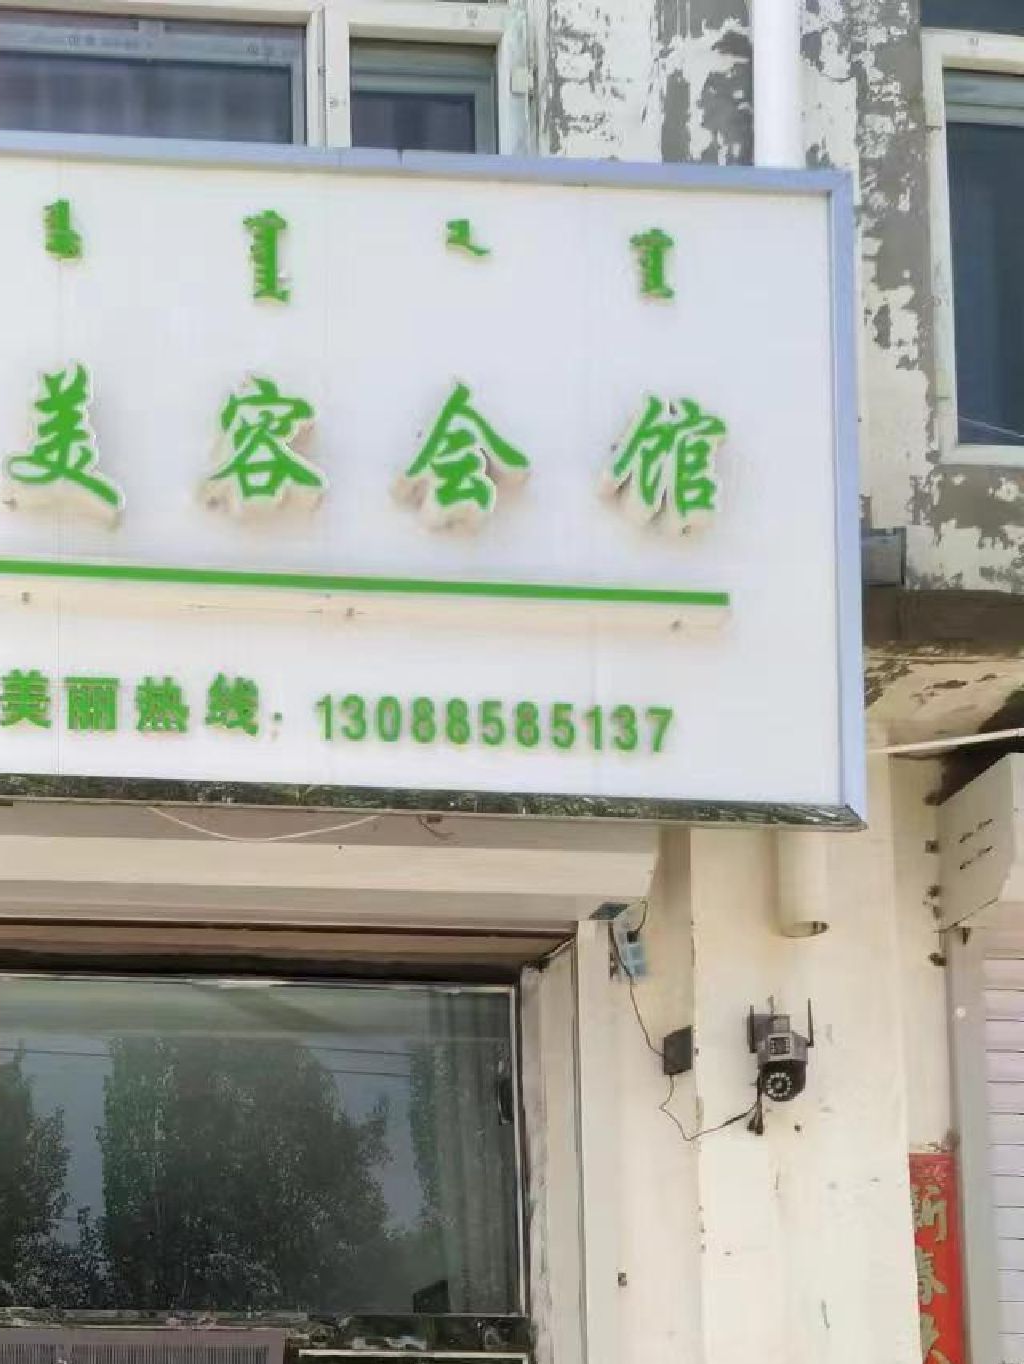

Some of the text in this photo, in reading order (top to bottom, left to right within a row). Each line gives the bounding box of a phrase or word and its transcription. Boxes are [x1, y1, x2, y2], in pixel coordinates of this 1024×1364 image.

[8, 364, 728, 517] 美容会馆
[313, 693, 674, 752] 13088585137
